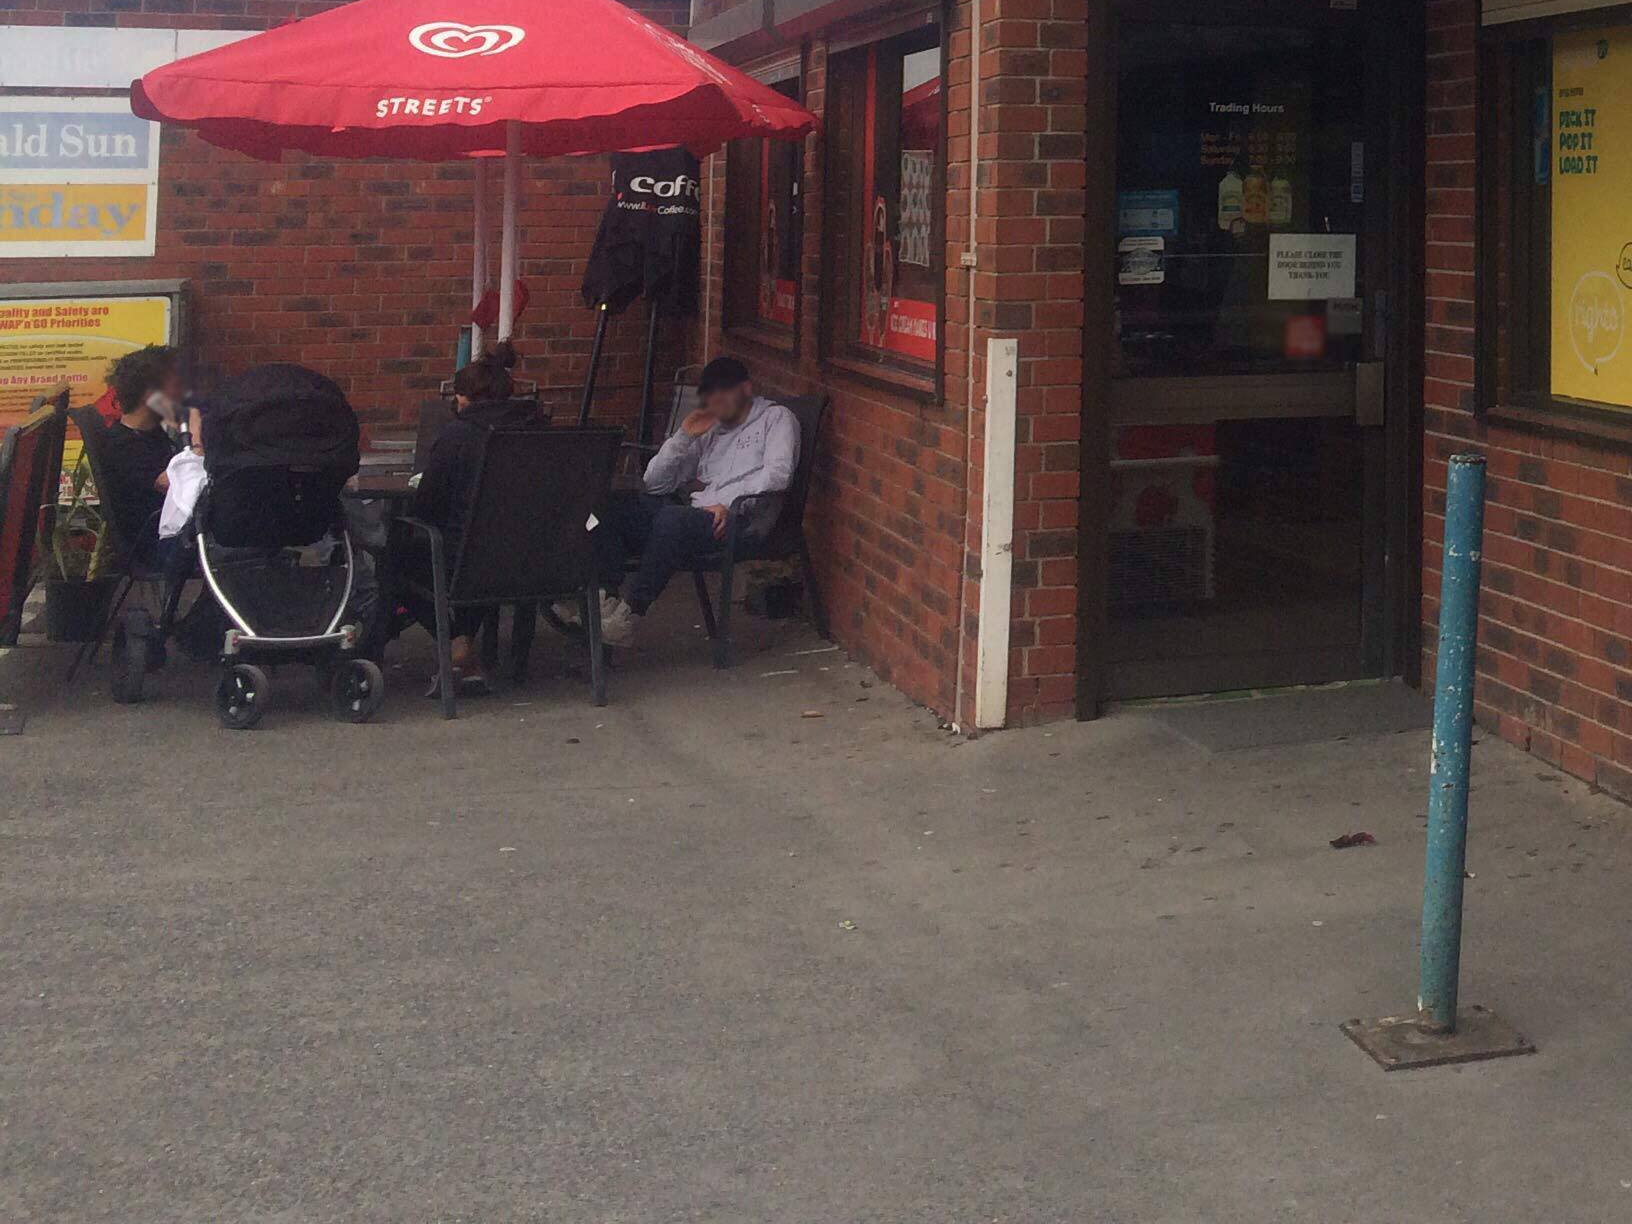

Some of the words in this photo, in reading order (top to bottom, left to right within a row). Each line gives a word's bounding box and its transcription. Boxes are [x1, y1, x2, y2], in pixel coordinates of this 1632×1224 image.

[1209, 102, 1250, 115] Trading
[1252, 103, 1285, 113] Hours
[1583, 108, 1597, 127] IT
[59, 123, 138, 158] Sun
[1580, 132, 1593, 151] IT
[1559, 156, 1584, 175] LOAD
[1585, 155, 1599, 175] IT
[31, 306, 53, 318] and
[55, 306, 90, 318] Safety
[91, 306, 110, 316] are
[50, 317, 101, 328] Priorities
[30, 373, 59, 385] Brand
